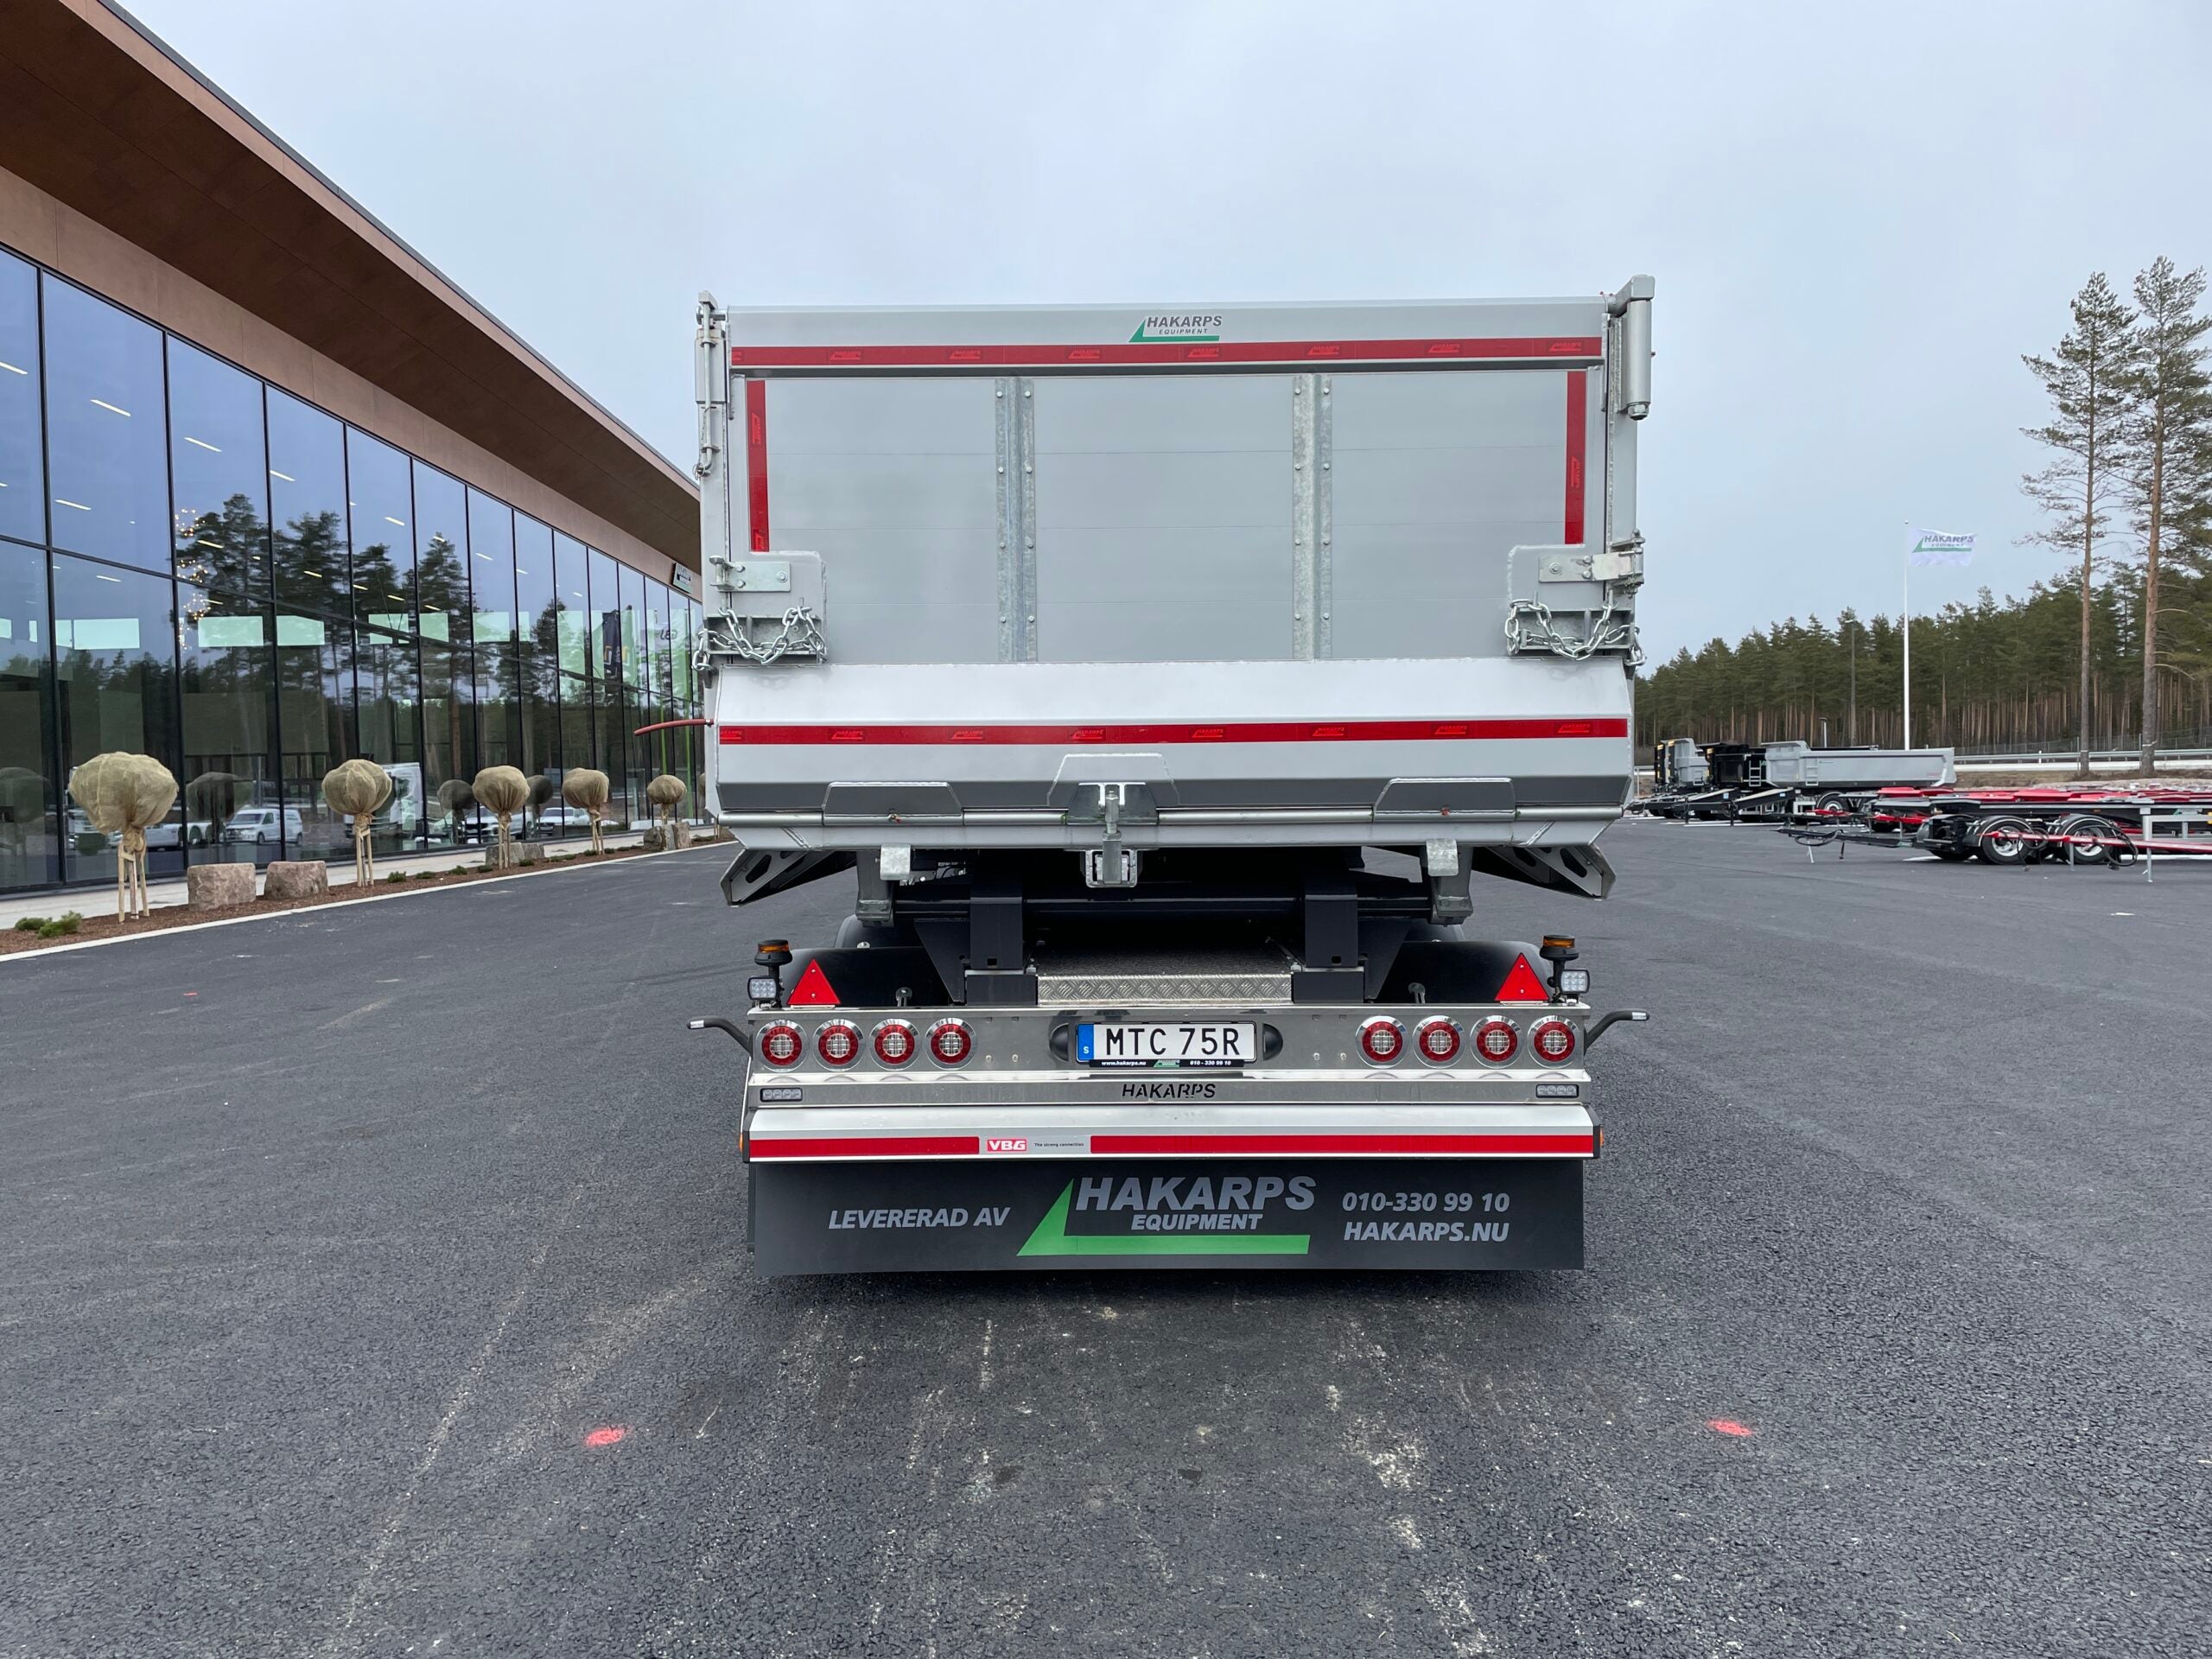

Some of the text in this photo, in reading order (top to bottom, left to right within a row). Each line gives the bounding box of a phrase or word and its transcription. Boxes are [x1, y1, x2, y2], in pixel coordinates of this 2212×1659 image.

[1147, 315, 1223, 327] HAKARPS
[1924, 535, 1974, 543] HAKARPS
[1106, 1027, 1240, 1056] MTC 75R
[1122, 1083, 1217, 1099] HAKARPS
[988, 1140, 1027, 1151] VBG
[1076, 1175, 1317, 1211] HAKARPS
[1341, 1192, 1510, 1212] 010-330 99 10
[828, 1206, 1012, 1230] LEVERERAD AV
[1130, 1213, 1263, 1232] EQUIPMENT
[1343, 1221, 1510, 1243] HAKARPS.NU
